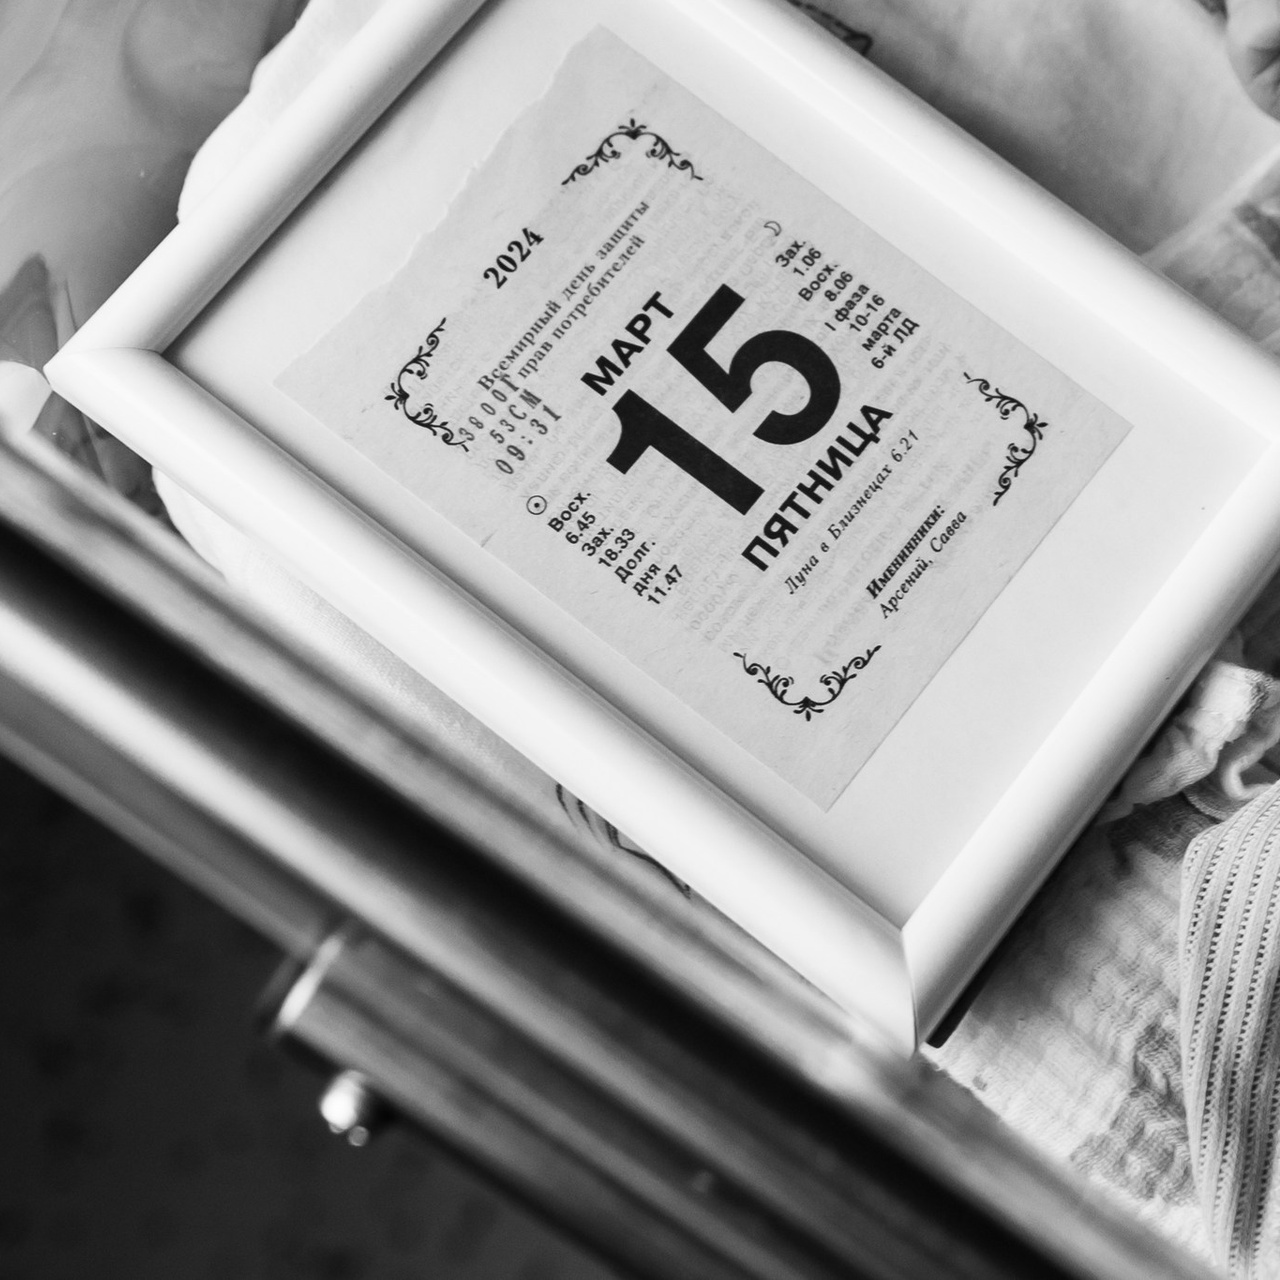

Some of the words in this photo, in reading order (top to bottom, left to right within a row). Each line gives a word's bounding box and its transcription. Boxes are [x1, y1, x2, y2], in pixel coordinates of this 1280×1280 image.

[483, 227, 545, 290] 2024
[774, 240, 807, 268] Зах.
[792, 247, 822, 276] 1.06
[476, 299, 562, 391] Всемирный
[561, 264, 596, 302] день
[595, 201, 650, 260] защиты
[797, 264, 839, 302] Восх.
[824, 271, 854, 302] 8.06
[834, 284, 871, 323] фаза
[517, 341, 554, 379] прав
[551, 234, 646, 340] потребителей
[849, 294, 885, 332] 10-16
[580, 290, 674, 397] МАРТ
[861, 307, 902, 352] марта
[870, 344, 897, 369] 6-й
[892, 317, 920, 344] ЛД
[606, 283, 841, 516] 15
[495, 404, 562, 475] 09:31
[741, 404, 894, 572] ПЯТНИЦА
[547, 492, 592, 533] Восх.
[565, 511, 596, 545] 6.45
[784, 555, 820, 595] Луна
[820, 541, 830, 553] в
[827, 464, 893, 541] Близнецах
[890, 429, 919, 463] 6.21
[581, 527, 615, 557] Зах.
[598, 528, 636, 568] 18.33
[614, 541, 656, 585] Долг.
[865, 504, 946, 600] Именинники:
[632, 563, 662, 597] дня
[647, 564, 683, 605] 11.47
[880, 558, 934, 620] Арсений,
[929, 511, 967, 553] Савва
